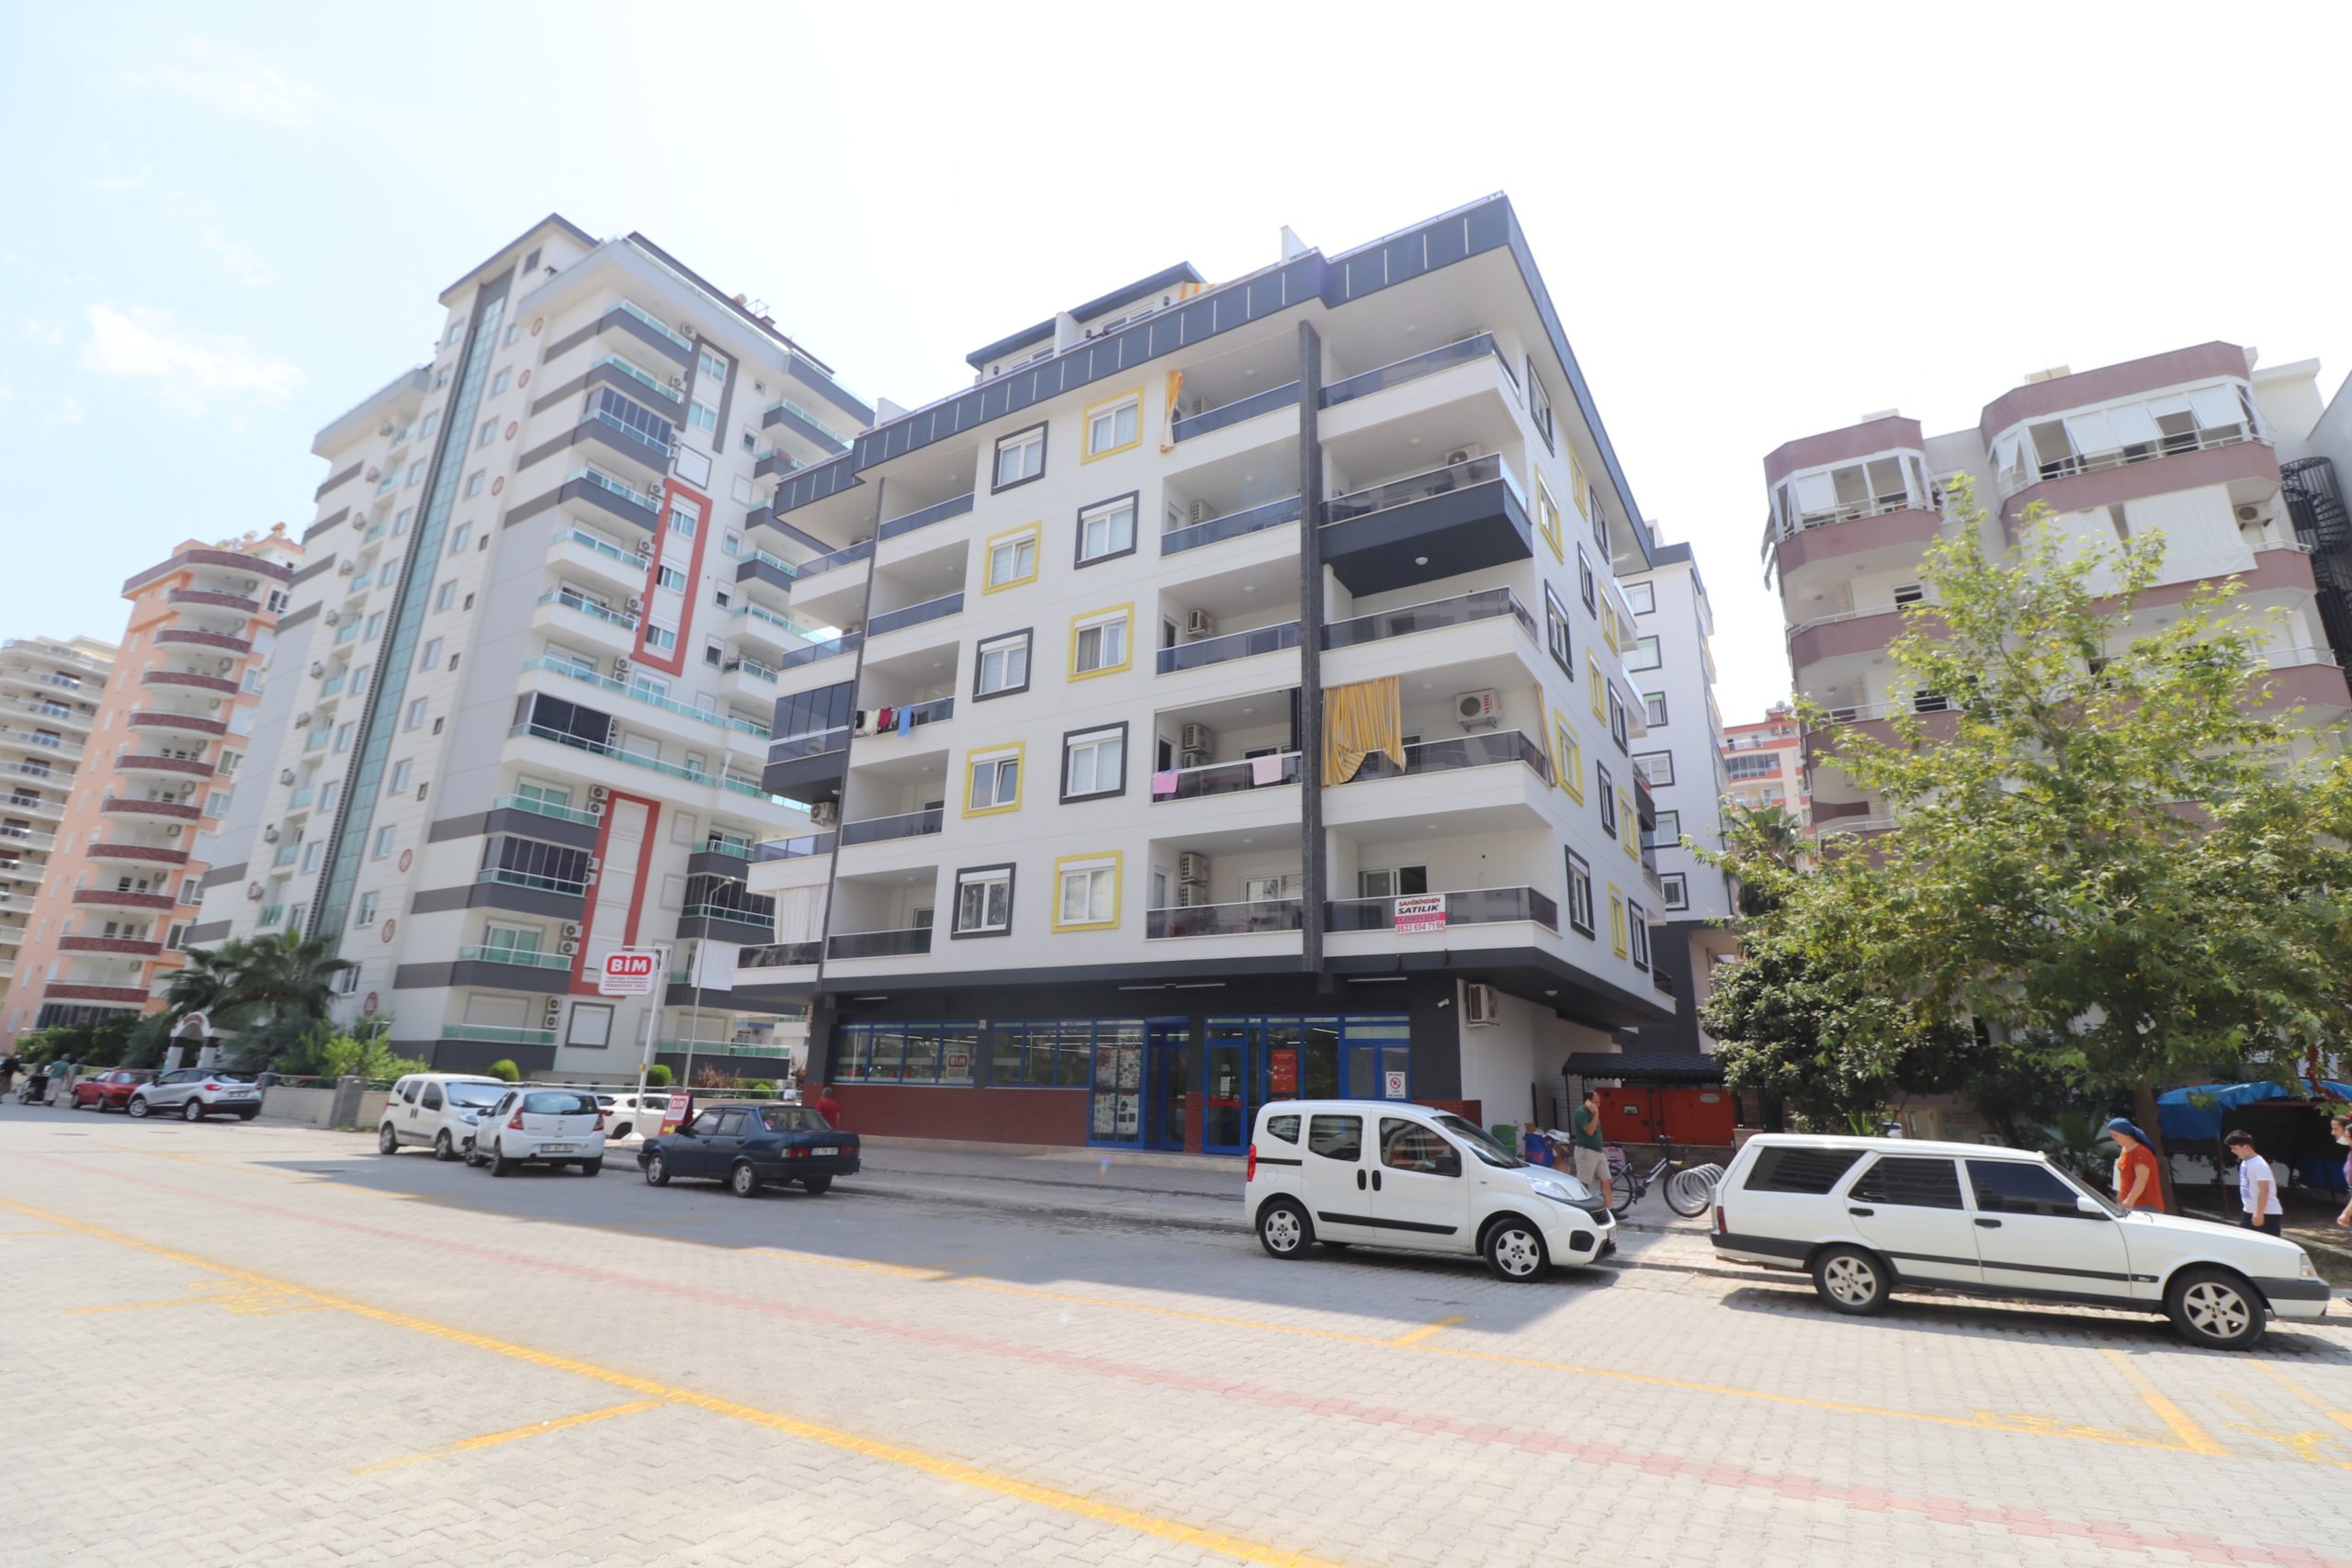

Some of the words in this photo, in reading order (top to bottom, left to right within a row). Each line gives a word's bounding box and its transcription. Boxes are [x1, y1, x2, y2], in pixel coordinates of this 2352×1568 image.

[1398, 905, 1439, 914] SATILIK
[1396, 924, 1412, 932] 0533
[1414, 922, 1426, 931] 654
[1436, 920, 1445, 929] 66
